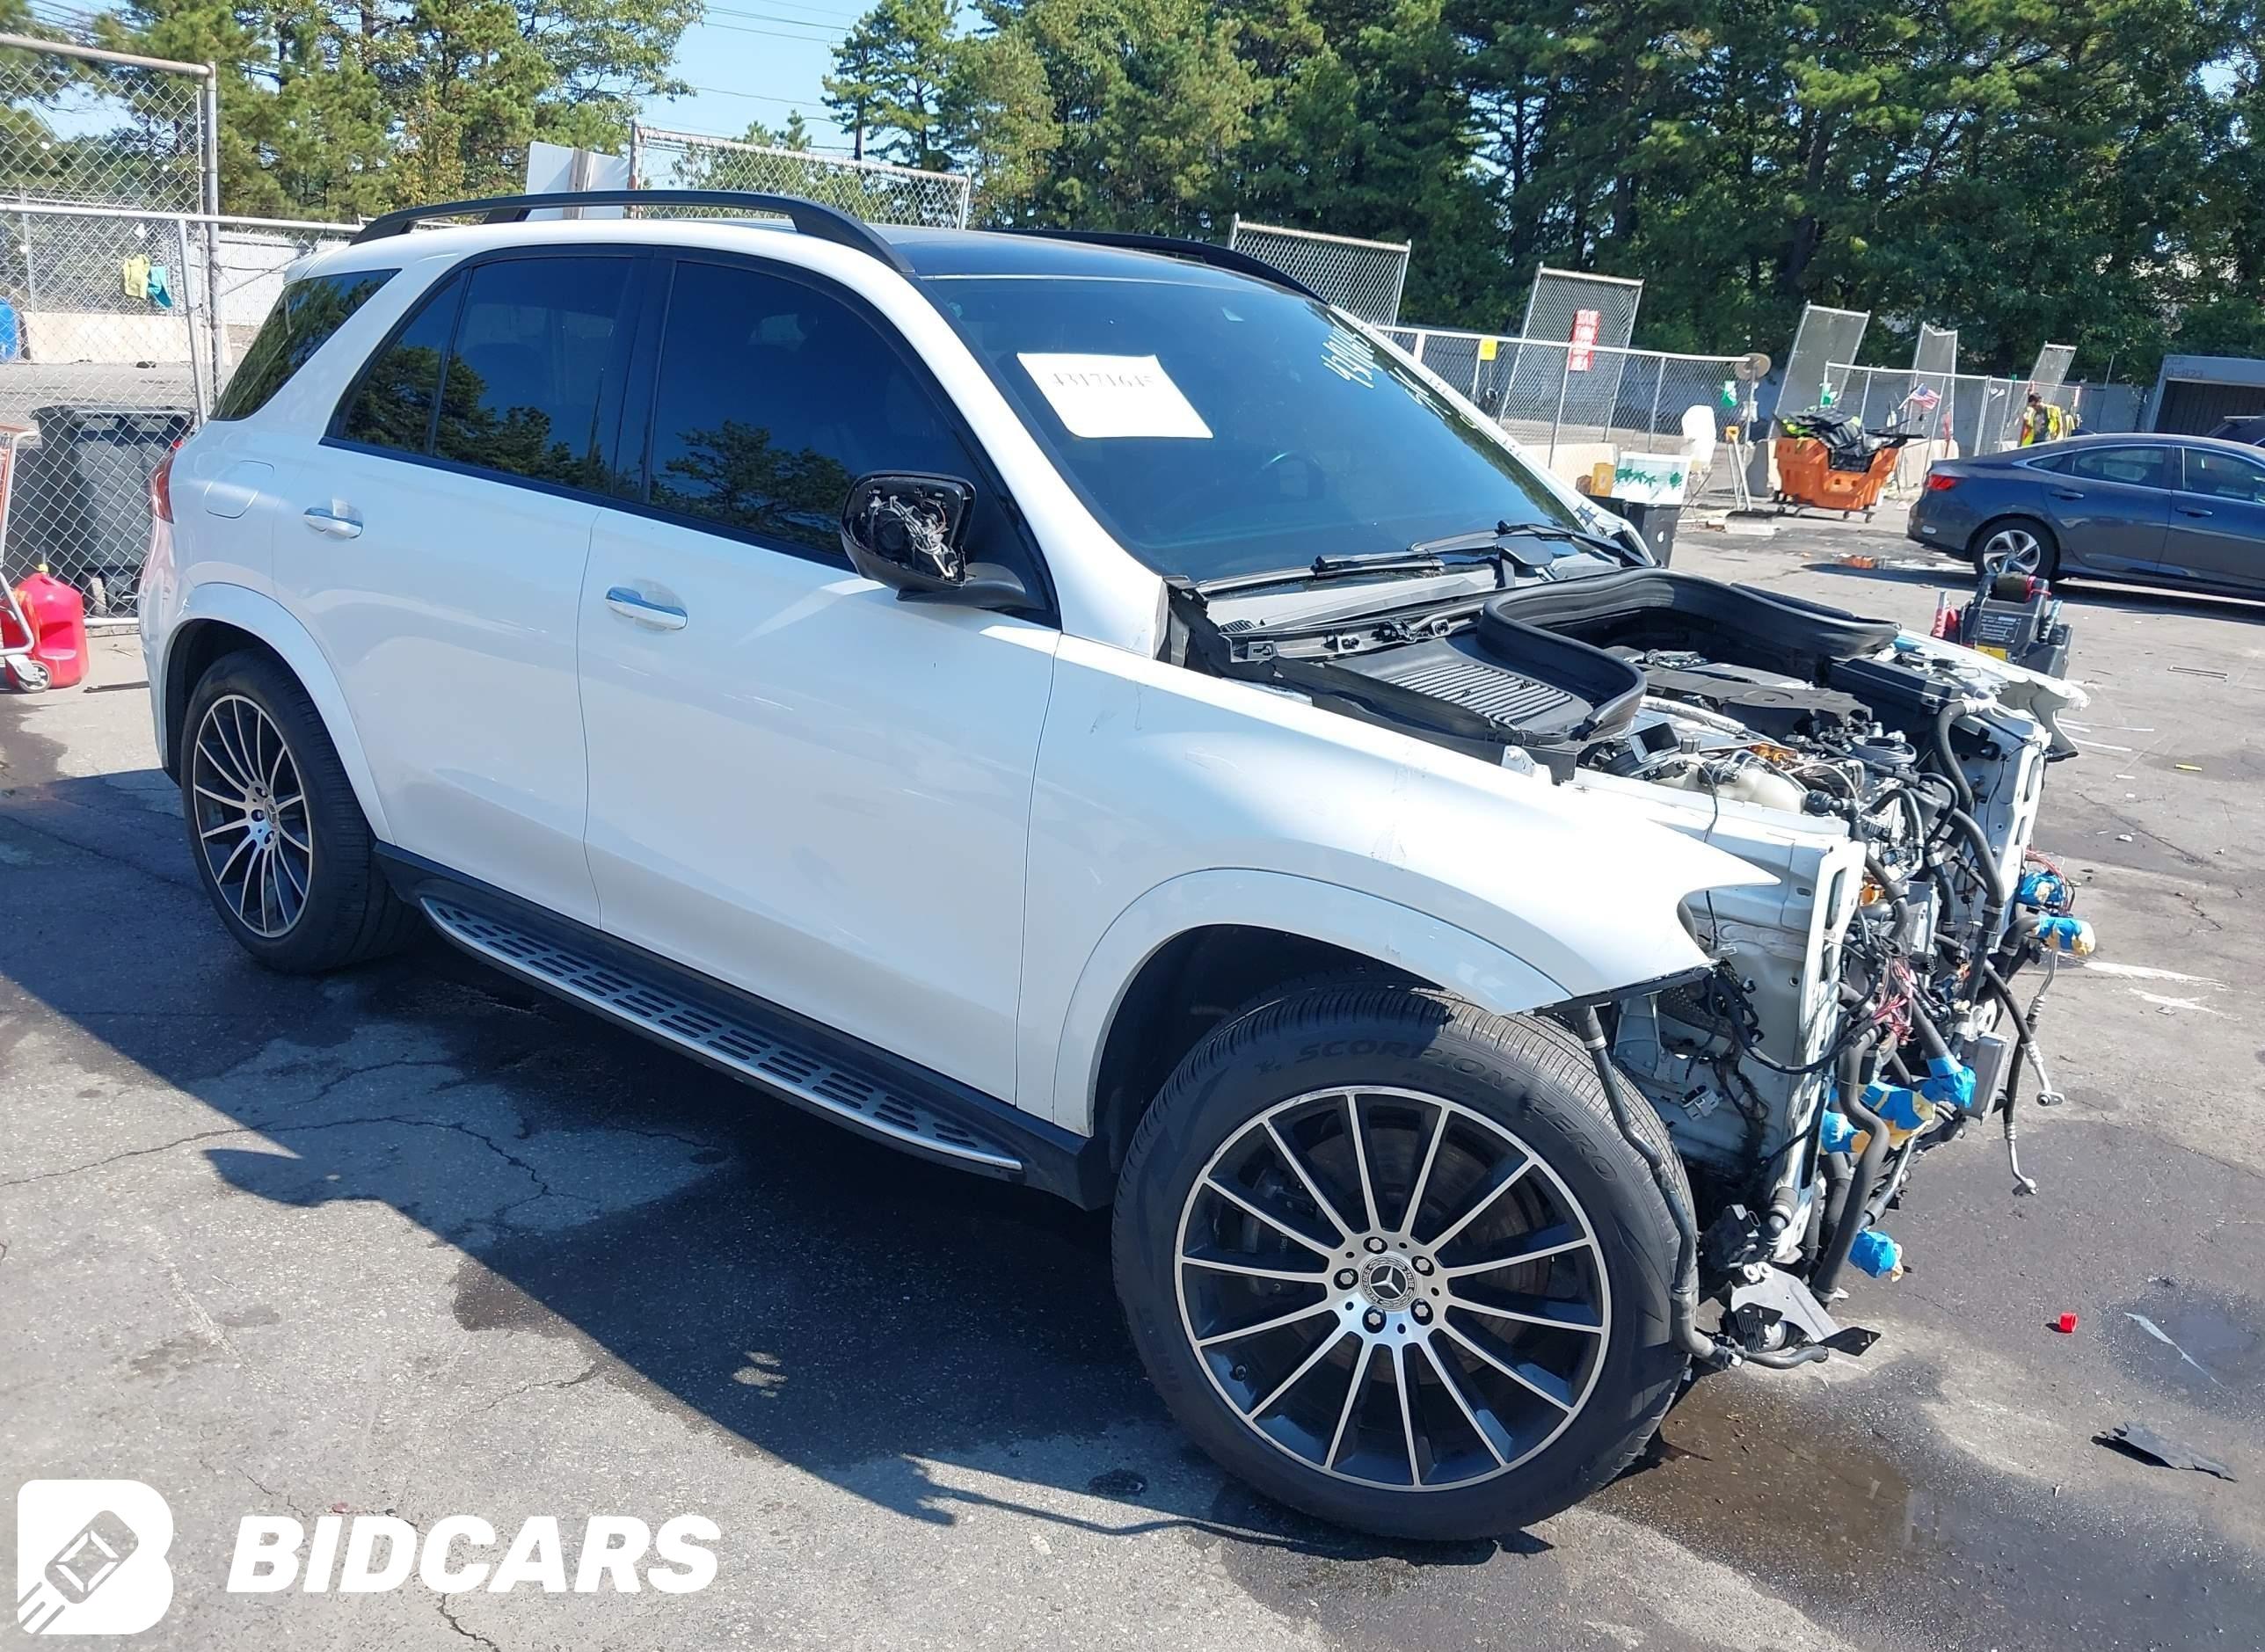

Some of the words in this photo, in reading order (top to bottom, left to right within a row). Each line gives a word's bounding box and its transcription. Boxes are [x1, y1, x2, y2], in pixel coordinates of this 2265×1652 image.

[1294, 1039, 1528, 1091] SCORPION
[1527, 1092, 1619, 1183] ZERO
[1362, 1268, 1380, 1303] MERCEDES
[1404, 1269, 1415, 1288] BENZ
